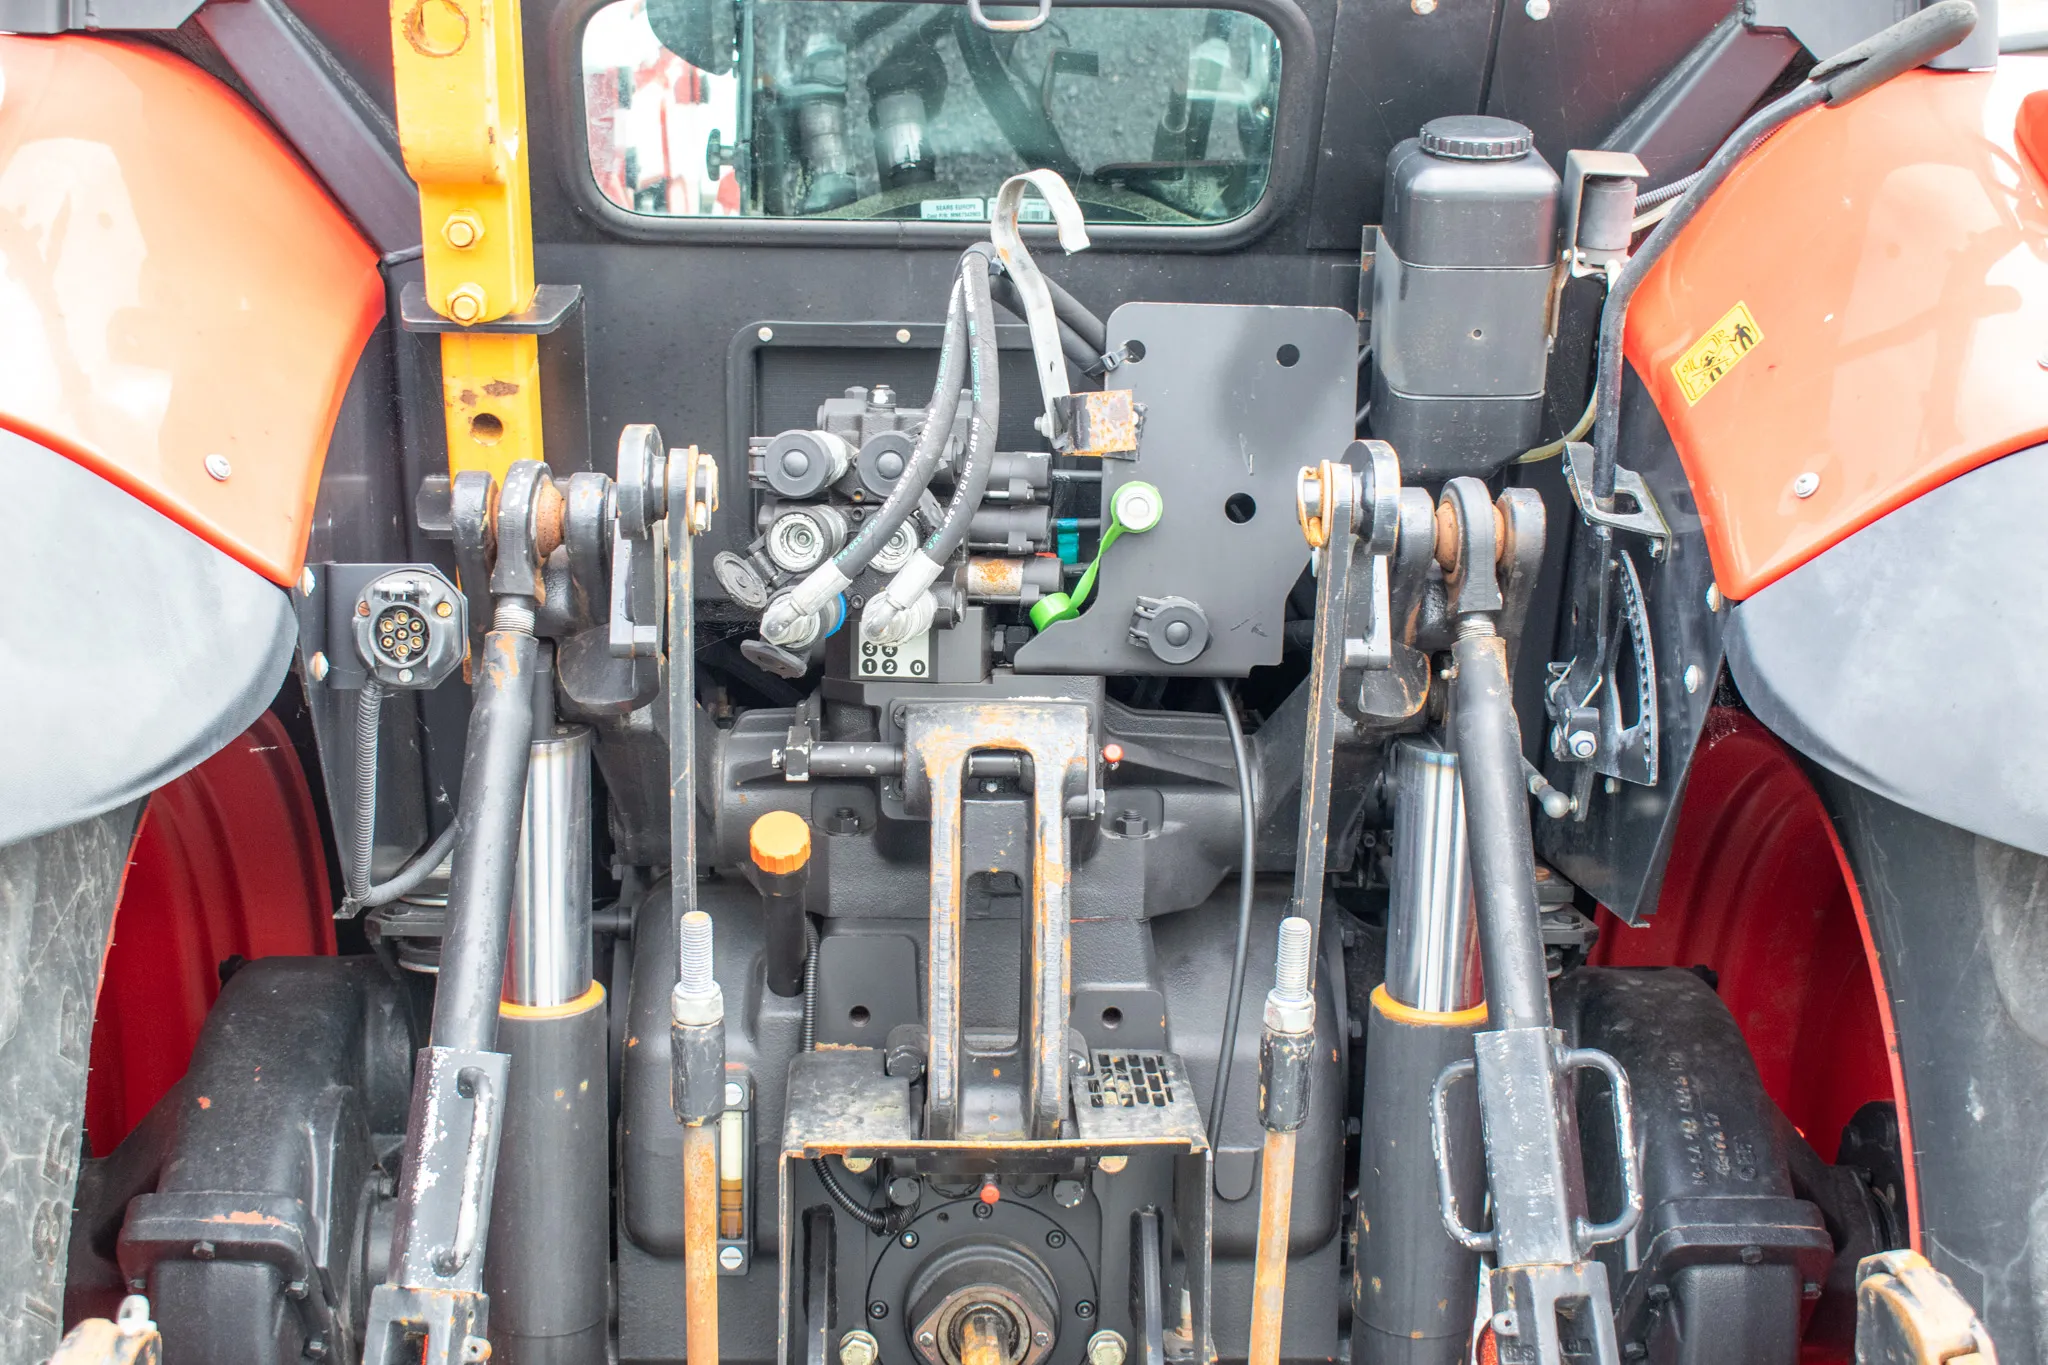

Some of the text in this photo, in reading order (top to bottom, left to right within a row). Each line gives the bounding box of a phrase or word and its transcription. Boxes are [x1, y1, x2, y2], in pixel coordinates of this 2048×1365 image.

[963, 462, 973, 477] DN
[866, 644, 894, 654] 3 4
[866, 661, 922, 672] 1 2 0
